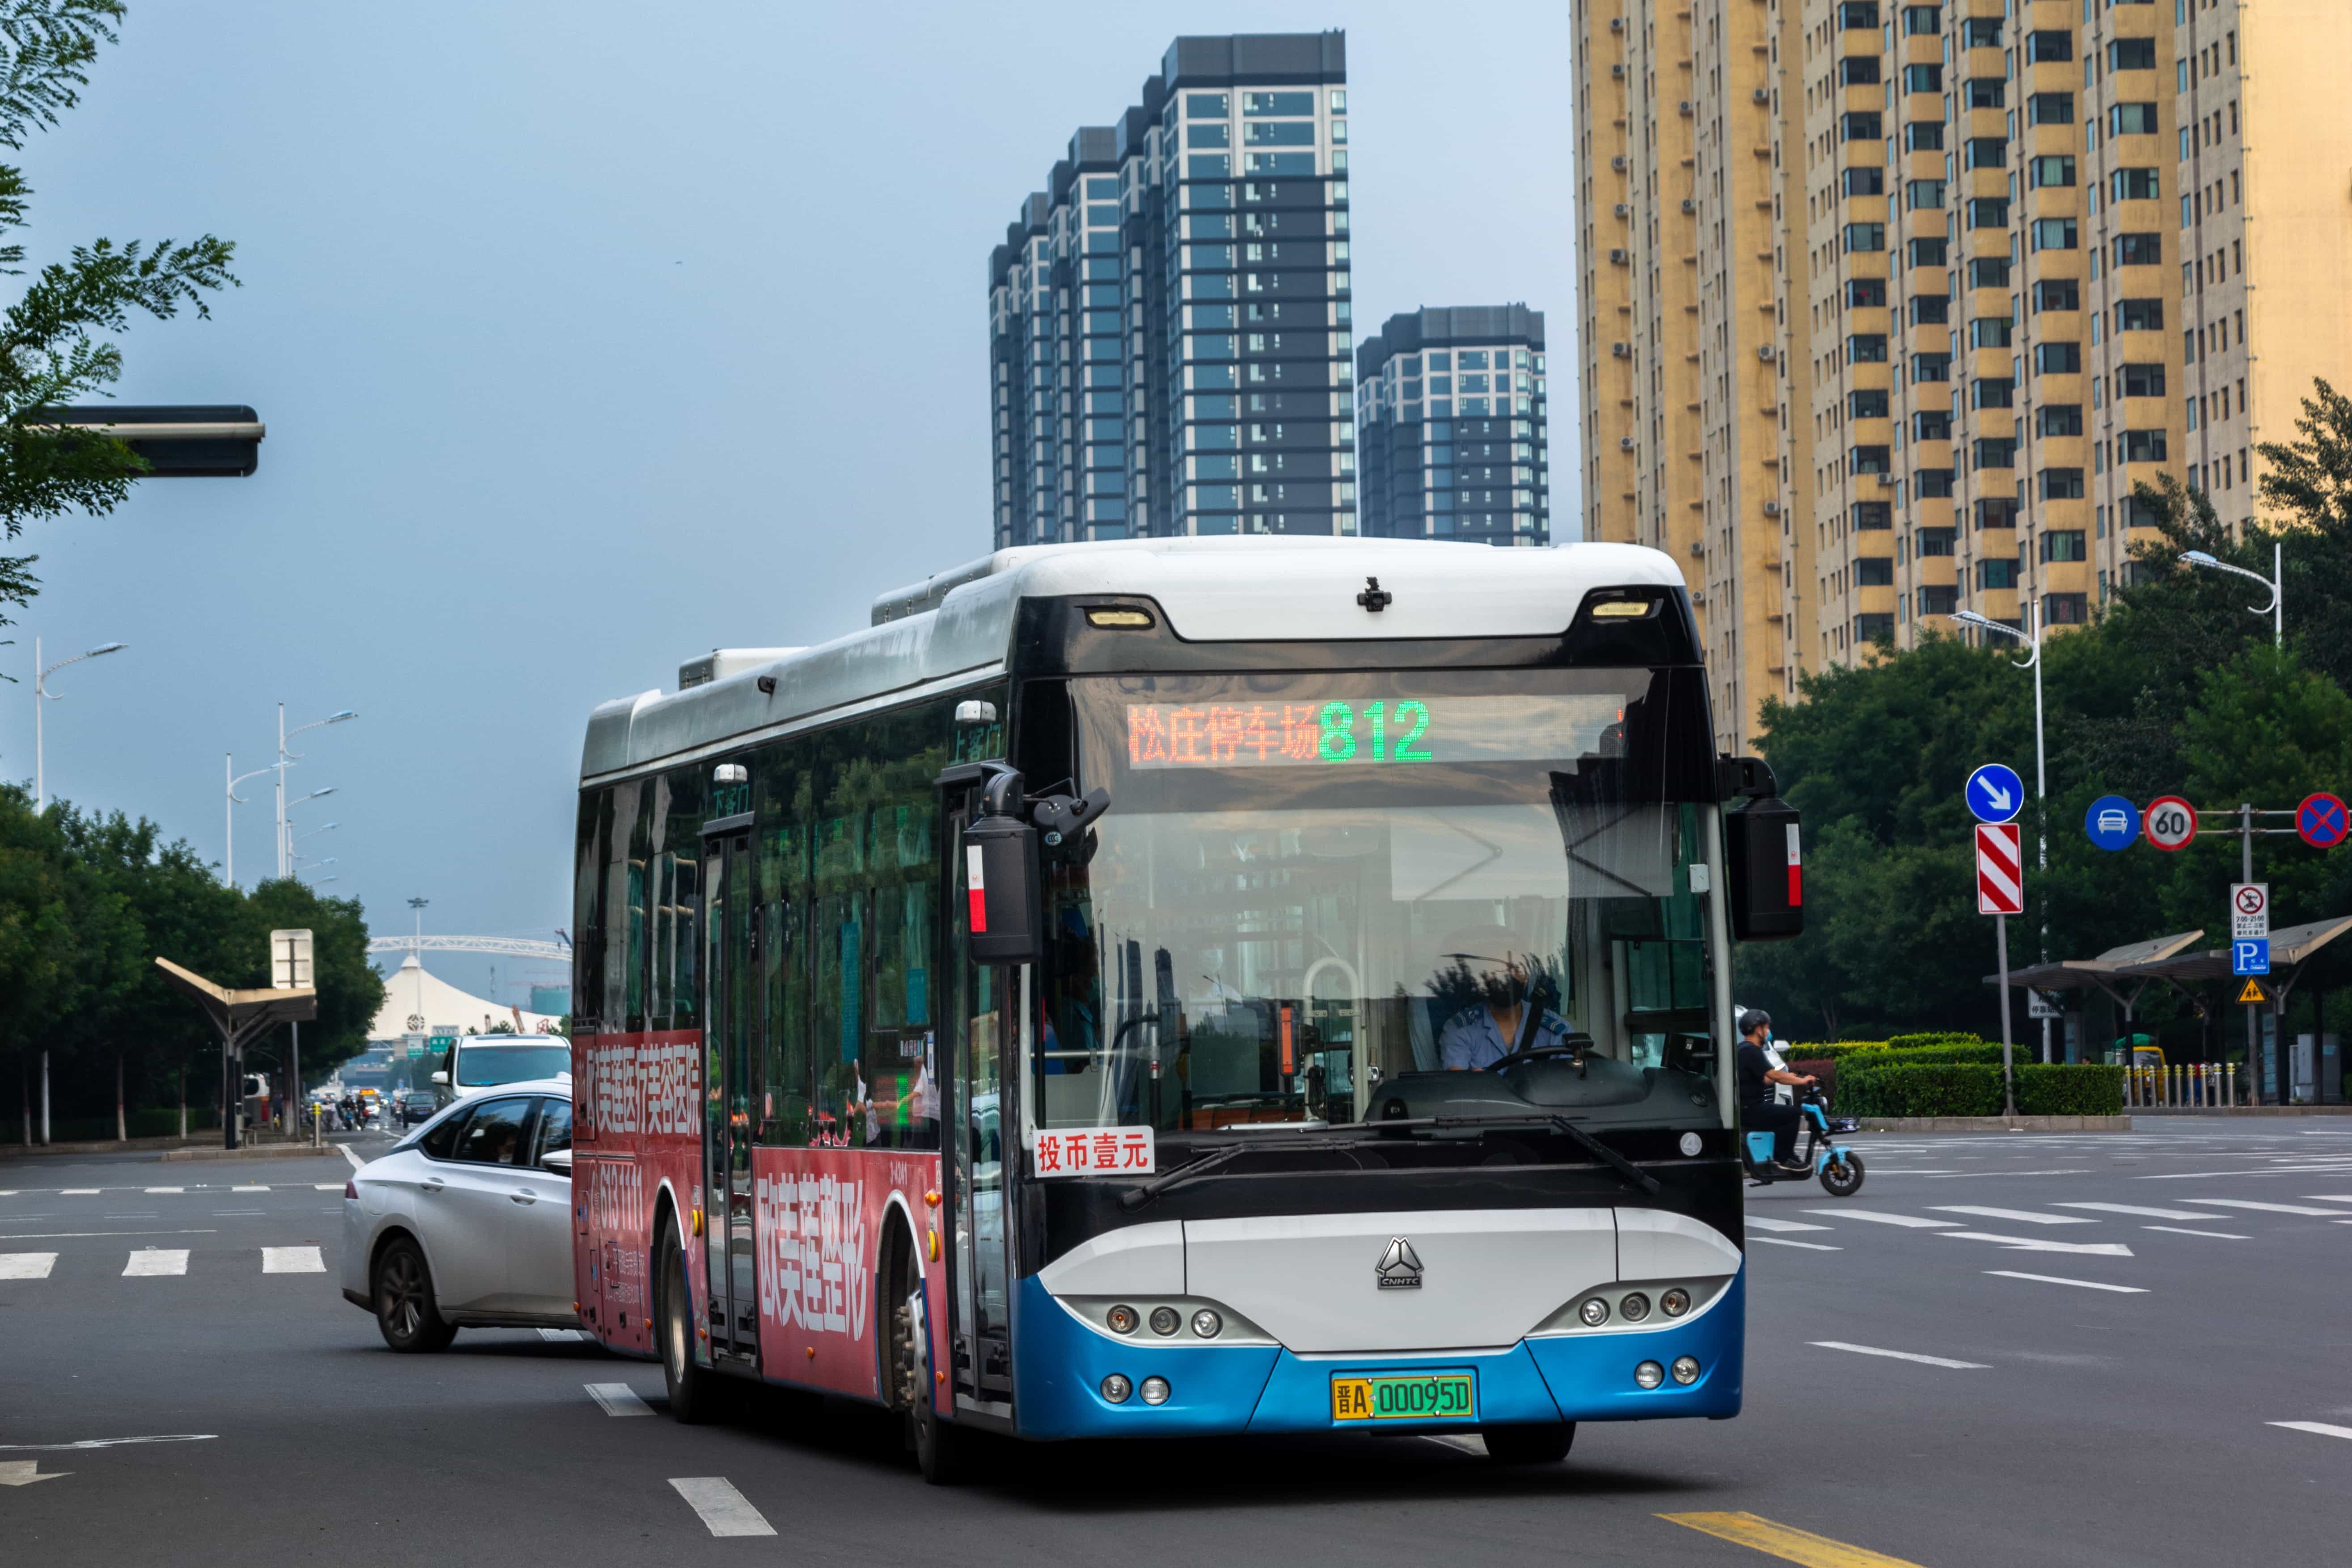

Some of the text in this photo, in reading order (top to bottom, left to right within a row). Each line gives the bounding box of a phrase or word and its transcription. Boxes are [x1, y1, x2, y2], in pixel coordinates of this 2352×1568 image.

[950, 723, 1001, 765] 上客门
[1128, 700, 1431, 763] 松庄停车场 812
[714, 783, 749, 819] 下客门
[2155, 811, 2185, 835] 60
[2237, 943, 2258, 970] P
[587, 1042, 701, 1137] 欧美莲医疗美容医院
[1038, 1133, 1148, 1171] 投币壹元
[600, 1164, 643, 1232] 6131111
[757, 1173, 867, 1341] 欧美莲整形
